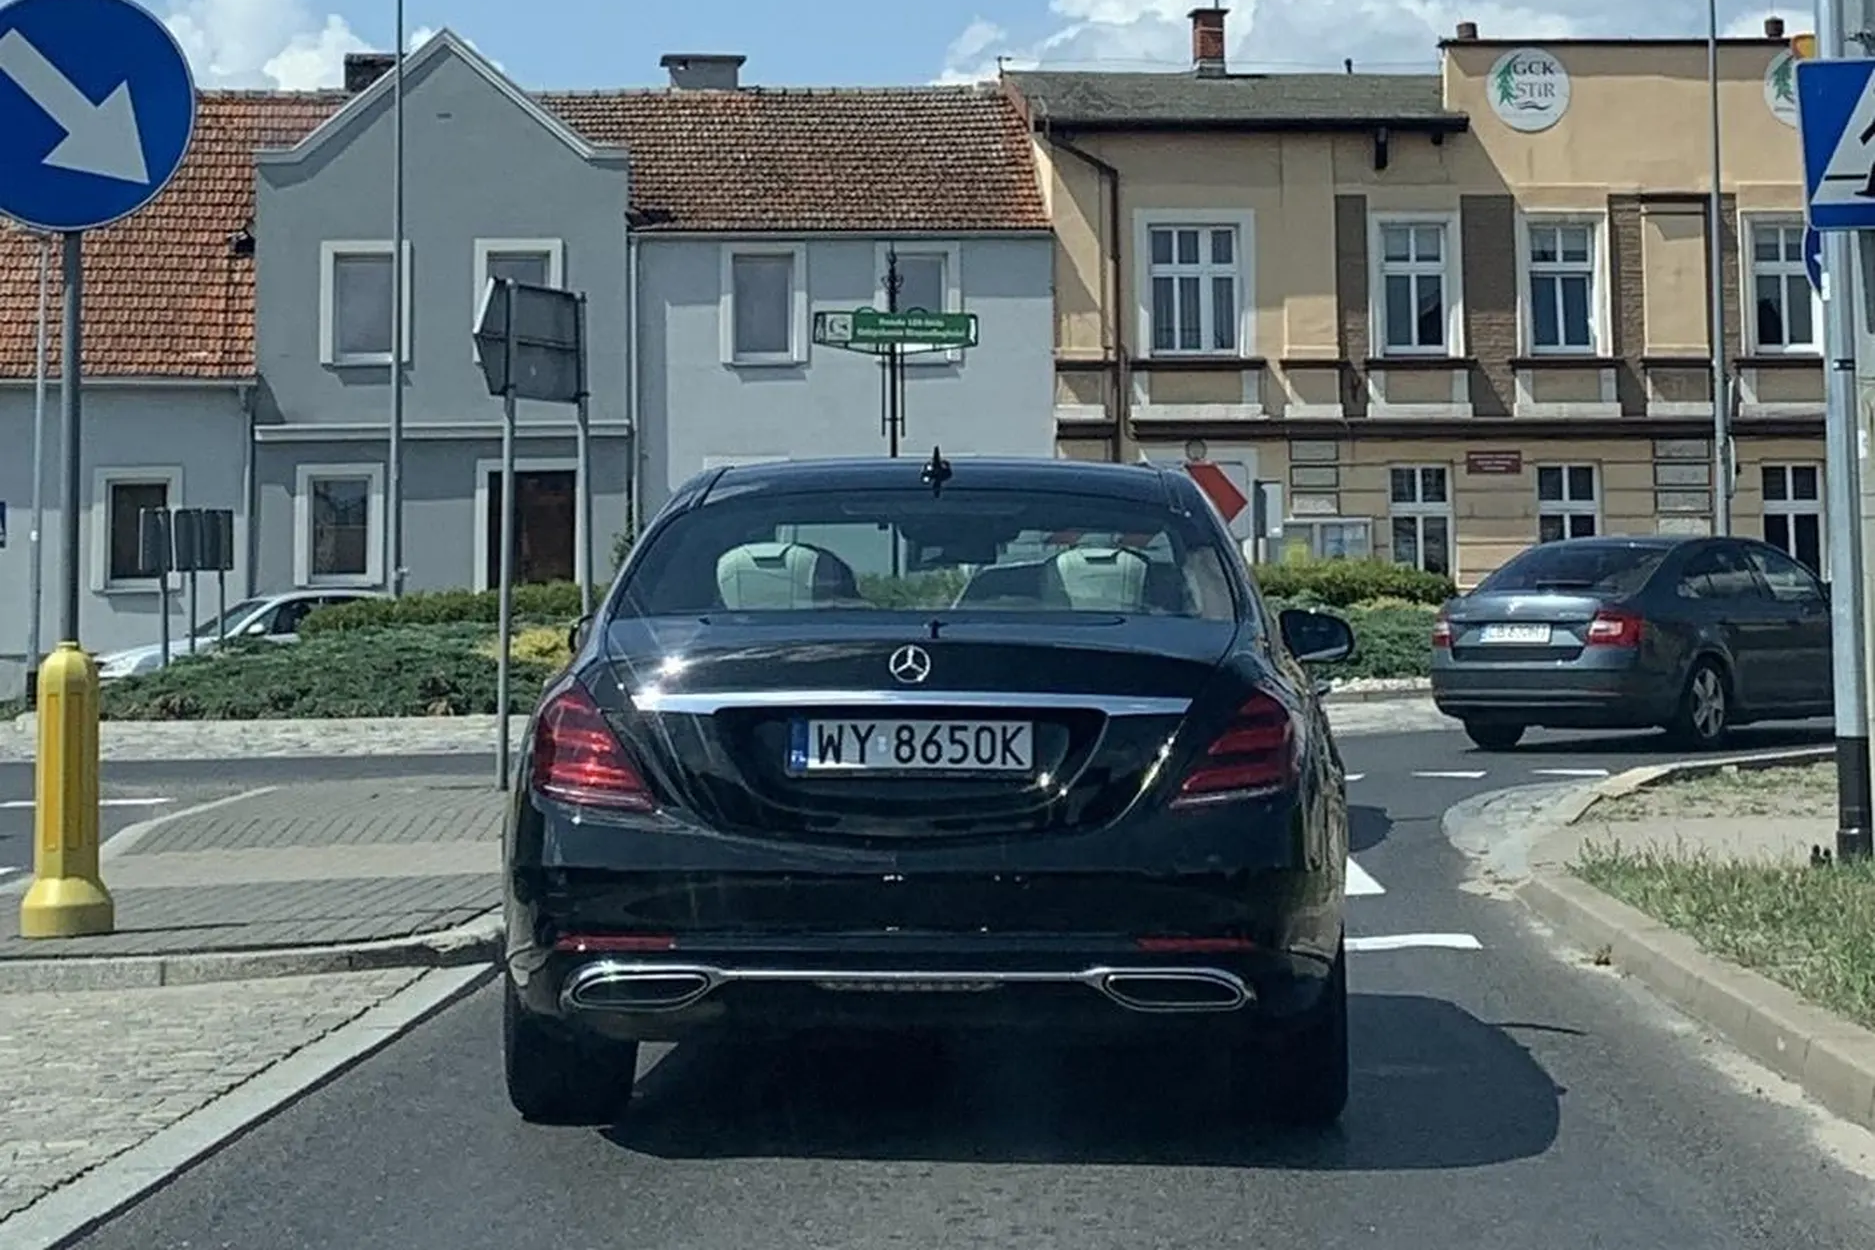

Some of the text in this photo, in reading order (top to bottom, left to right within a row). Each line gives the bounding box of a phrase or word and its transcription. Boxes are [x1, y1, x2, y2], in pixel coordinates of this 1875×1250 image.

[1513, 61, 1555, 75] GCK
[817, 723, 1025, 766] WY 8650K
